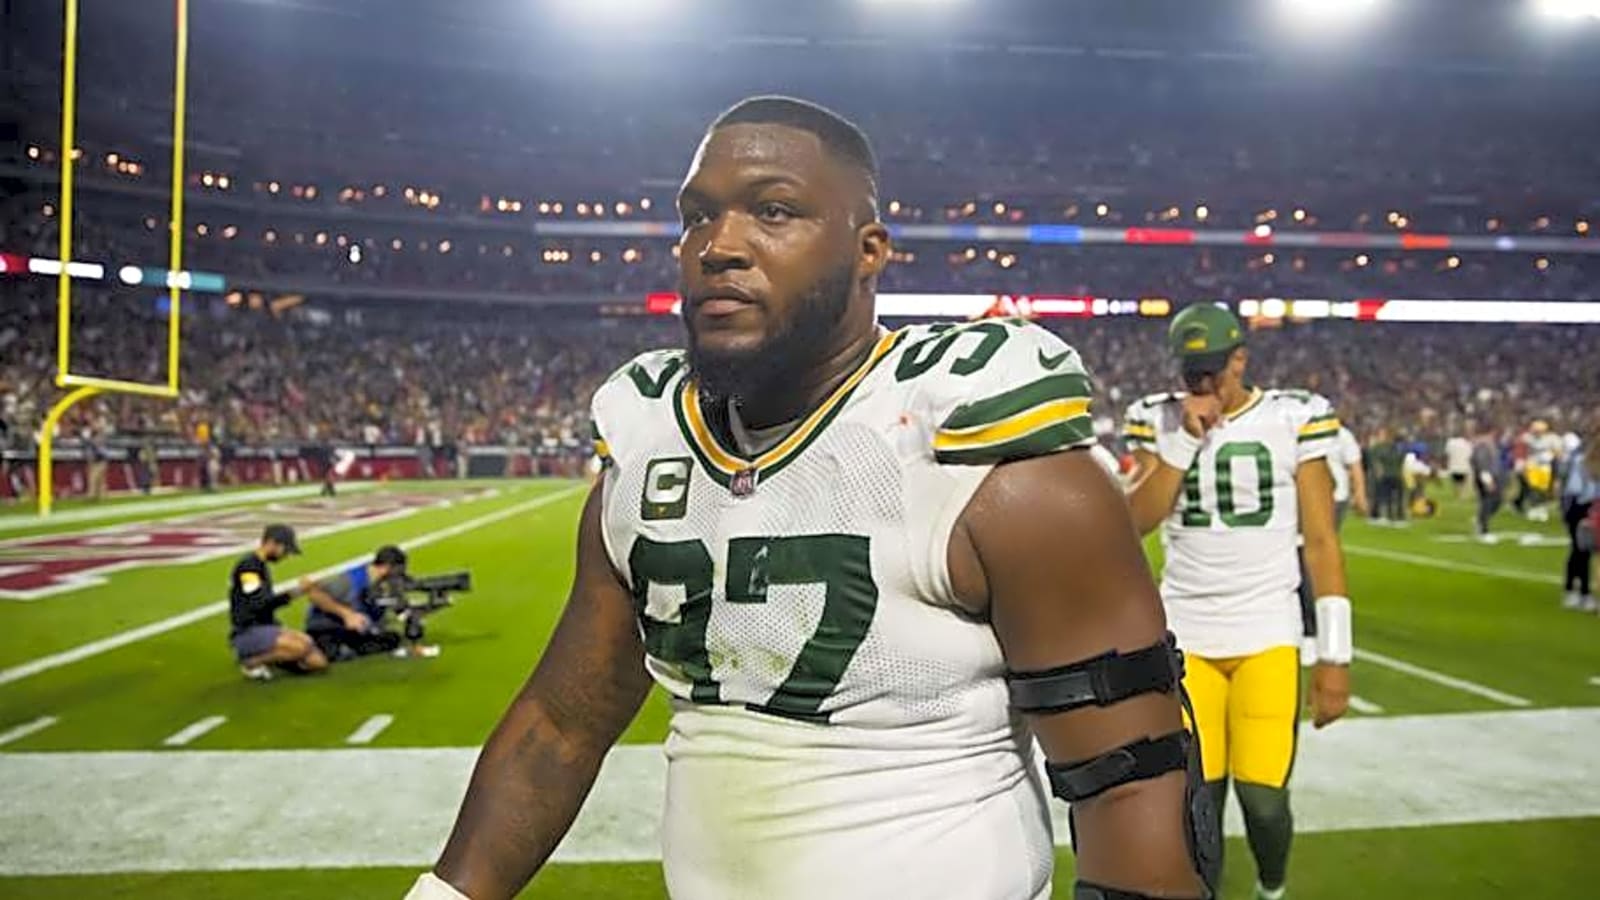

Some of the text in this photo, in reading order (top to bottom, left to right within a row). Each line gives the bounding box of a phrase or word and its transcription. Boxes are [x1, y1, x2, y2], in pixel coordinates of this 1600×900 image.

[895, 319, 1023, 382] 9
[645, 461, 688, 503] C
[1182, 441, 1274, 527] 10
[628, 533, 879, 723] 97
